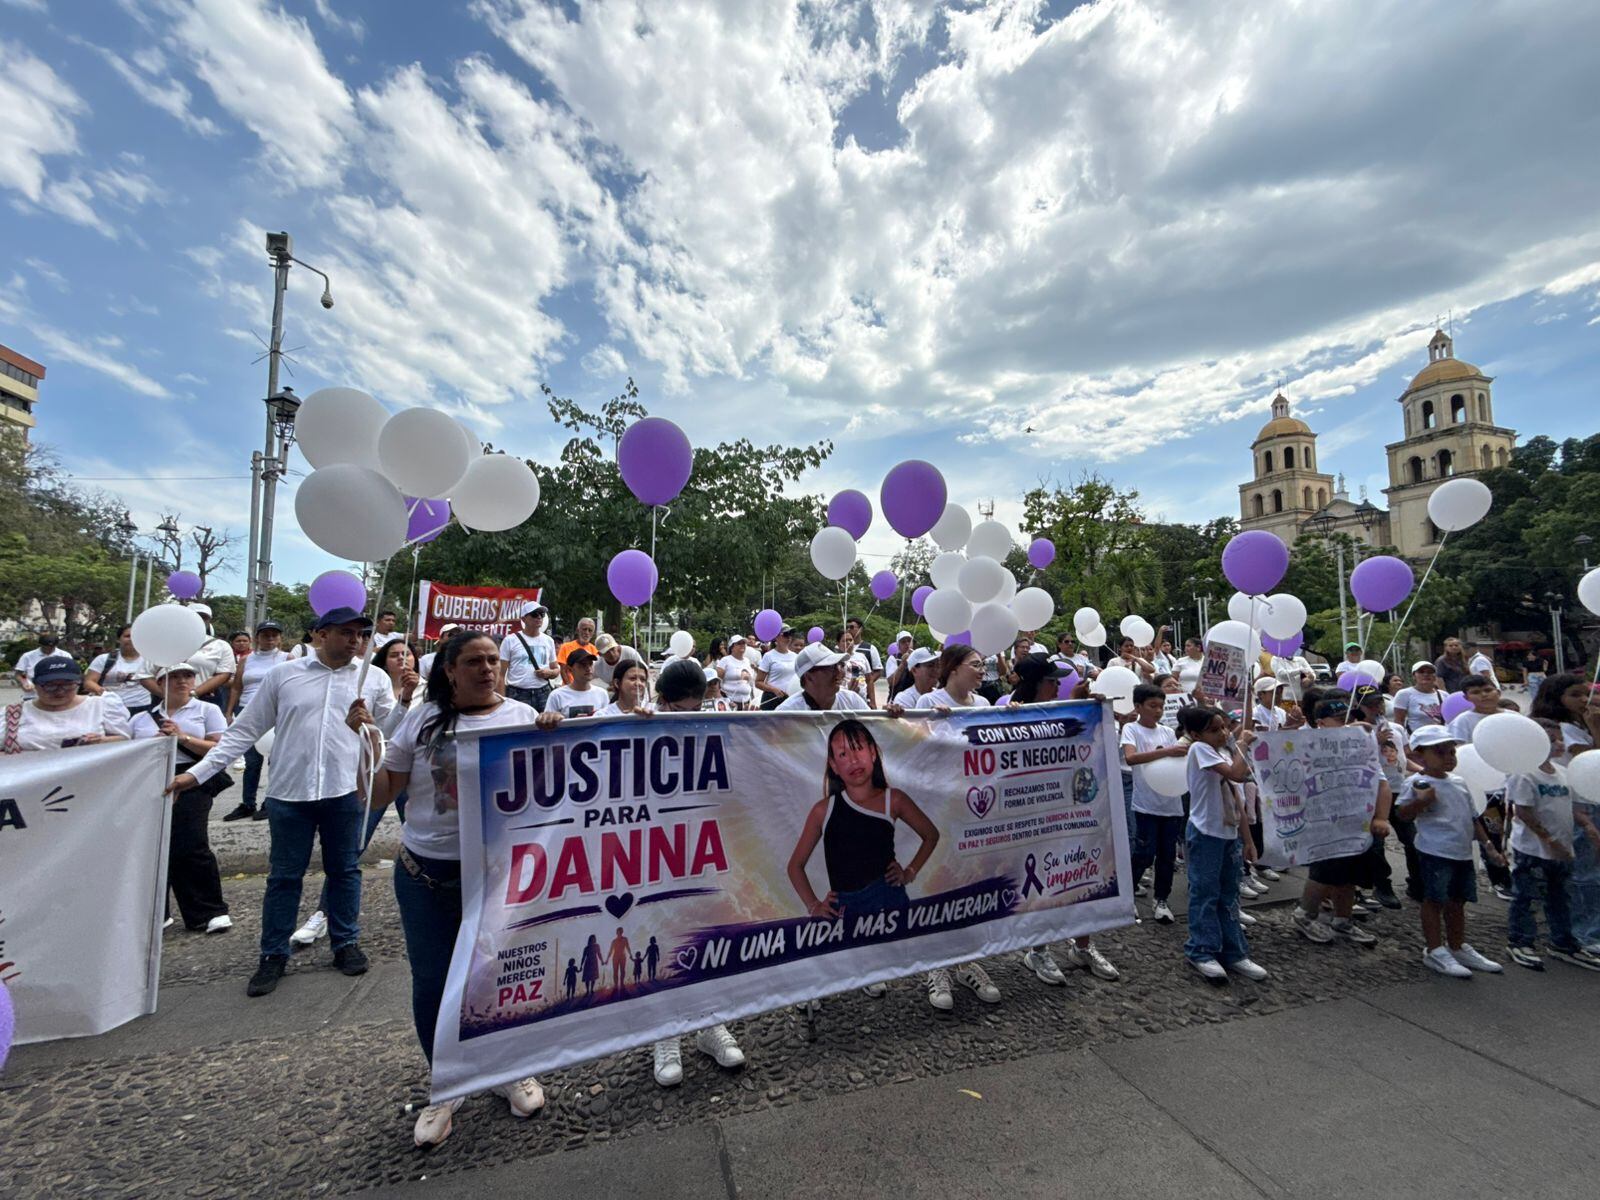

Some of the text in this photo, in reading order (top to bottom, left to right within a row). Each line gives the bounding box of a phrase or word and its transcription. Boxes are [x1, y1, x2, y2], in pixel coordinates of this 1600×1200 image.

[434, 595, 498, 620] CUBEROS
[1207, 660, 1226, 675] NO
[978, 722, 1066, 743] CON LOS NIÑOS
[964, 744, 1077, 776] NO SE NEGOCIA
[495, 734, 730, 813] JUSTICIA
[1004, 781, 1060, 797] RECHAZAMOS TODA
[1004, 798, 1026, 808] FORMA
[1027, 796, 1035, 805] DE
[583, 804, 651, 828] PARA
[964, 826, 993, 838] EXIGIMOS
[994, 824, 1006, 833] QUE
[1006, 822, 1014, 831] SE
[1015, 818, 1037, 829] RESPETE
[1070, 811, 1075, 819] A
[1075, 809, 1092, 818] VIVIR
[958, 842, 967, 850] EN
[967, 840, 979, 849] PAZ
[980, 839, 985, 847] Y
[1012, 830, 1032, 840] DENTRO
[1033, 828, 1040, 836] DE
[505, 819, 729, 906] DANNA
[1043, 844, 1087, 871] Su vida
[1046, 857, 1099, 890] importa
[700, 937, 731, 970] NI
[740, 928, 785, 962] UNA
[796, 918, 844, 950] VIDA
[907, 889, 999, 930] VULNERADA
[498, 941, 548, 961] NUESTROS
[503, 955, 541, 973] NIÑOS
[497, 966, 546, 987] MERECEN
[498, 979, 543, 1007] PAZ
